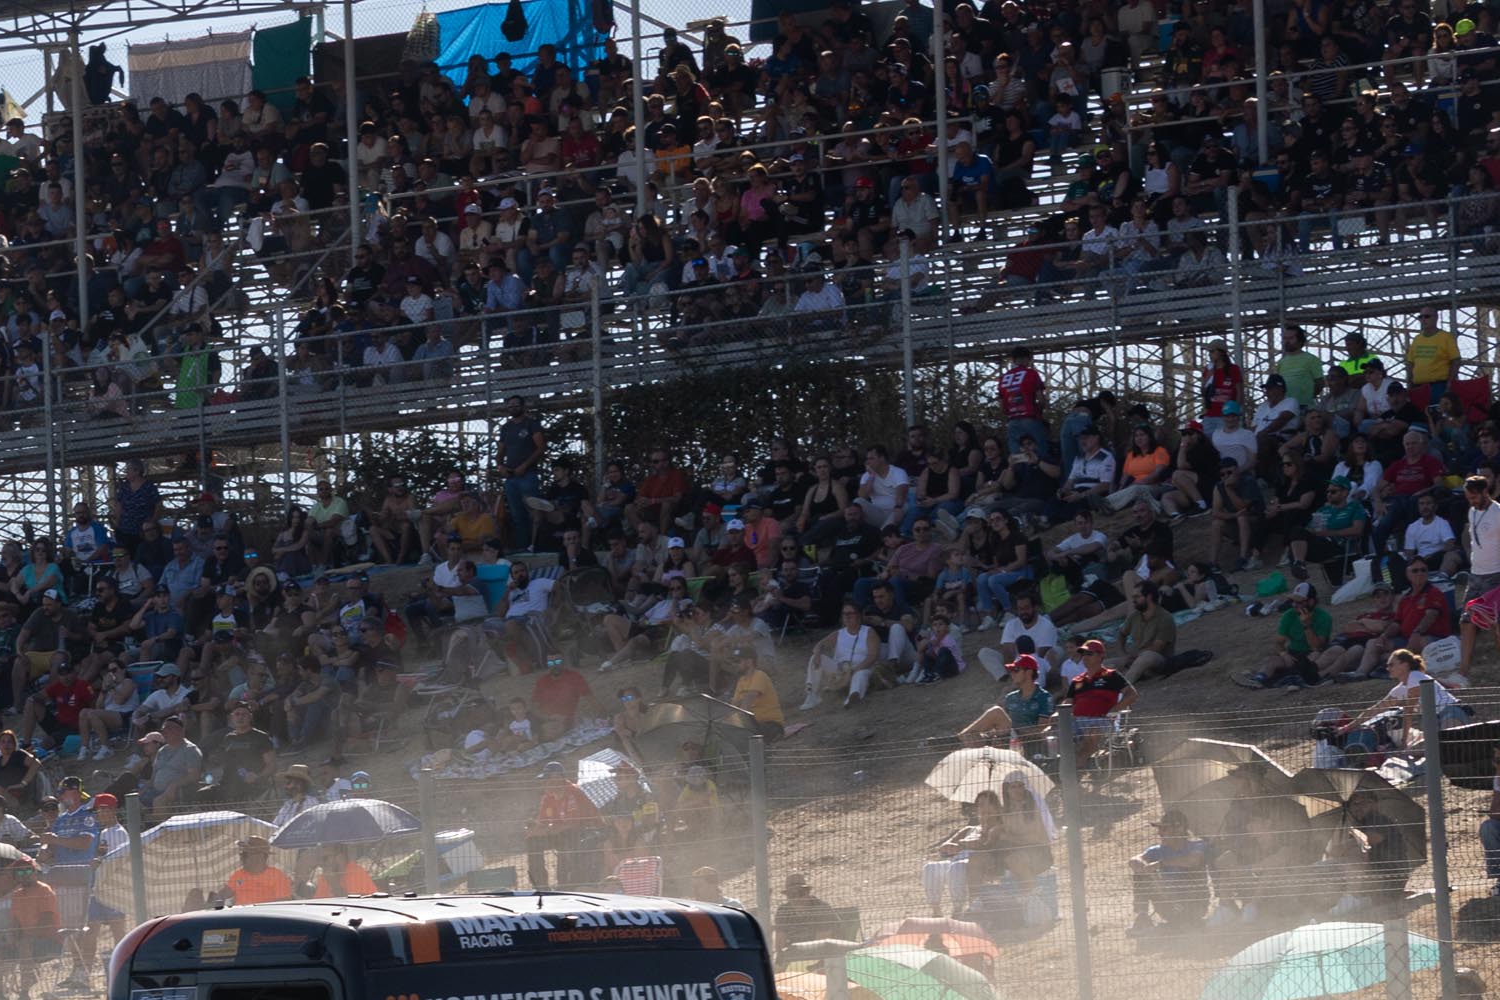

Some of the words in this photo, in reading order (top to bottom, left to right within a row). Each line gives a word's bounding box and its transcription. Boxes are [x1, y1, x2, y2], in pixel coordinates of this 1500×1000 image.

[1001, 371, 1027, 388] 93
[452, 913, 556, 935] MARK
[554, 909, 677, 928] AYLOR
[460, 932, 513, 950] RACING
